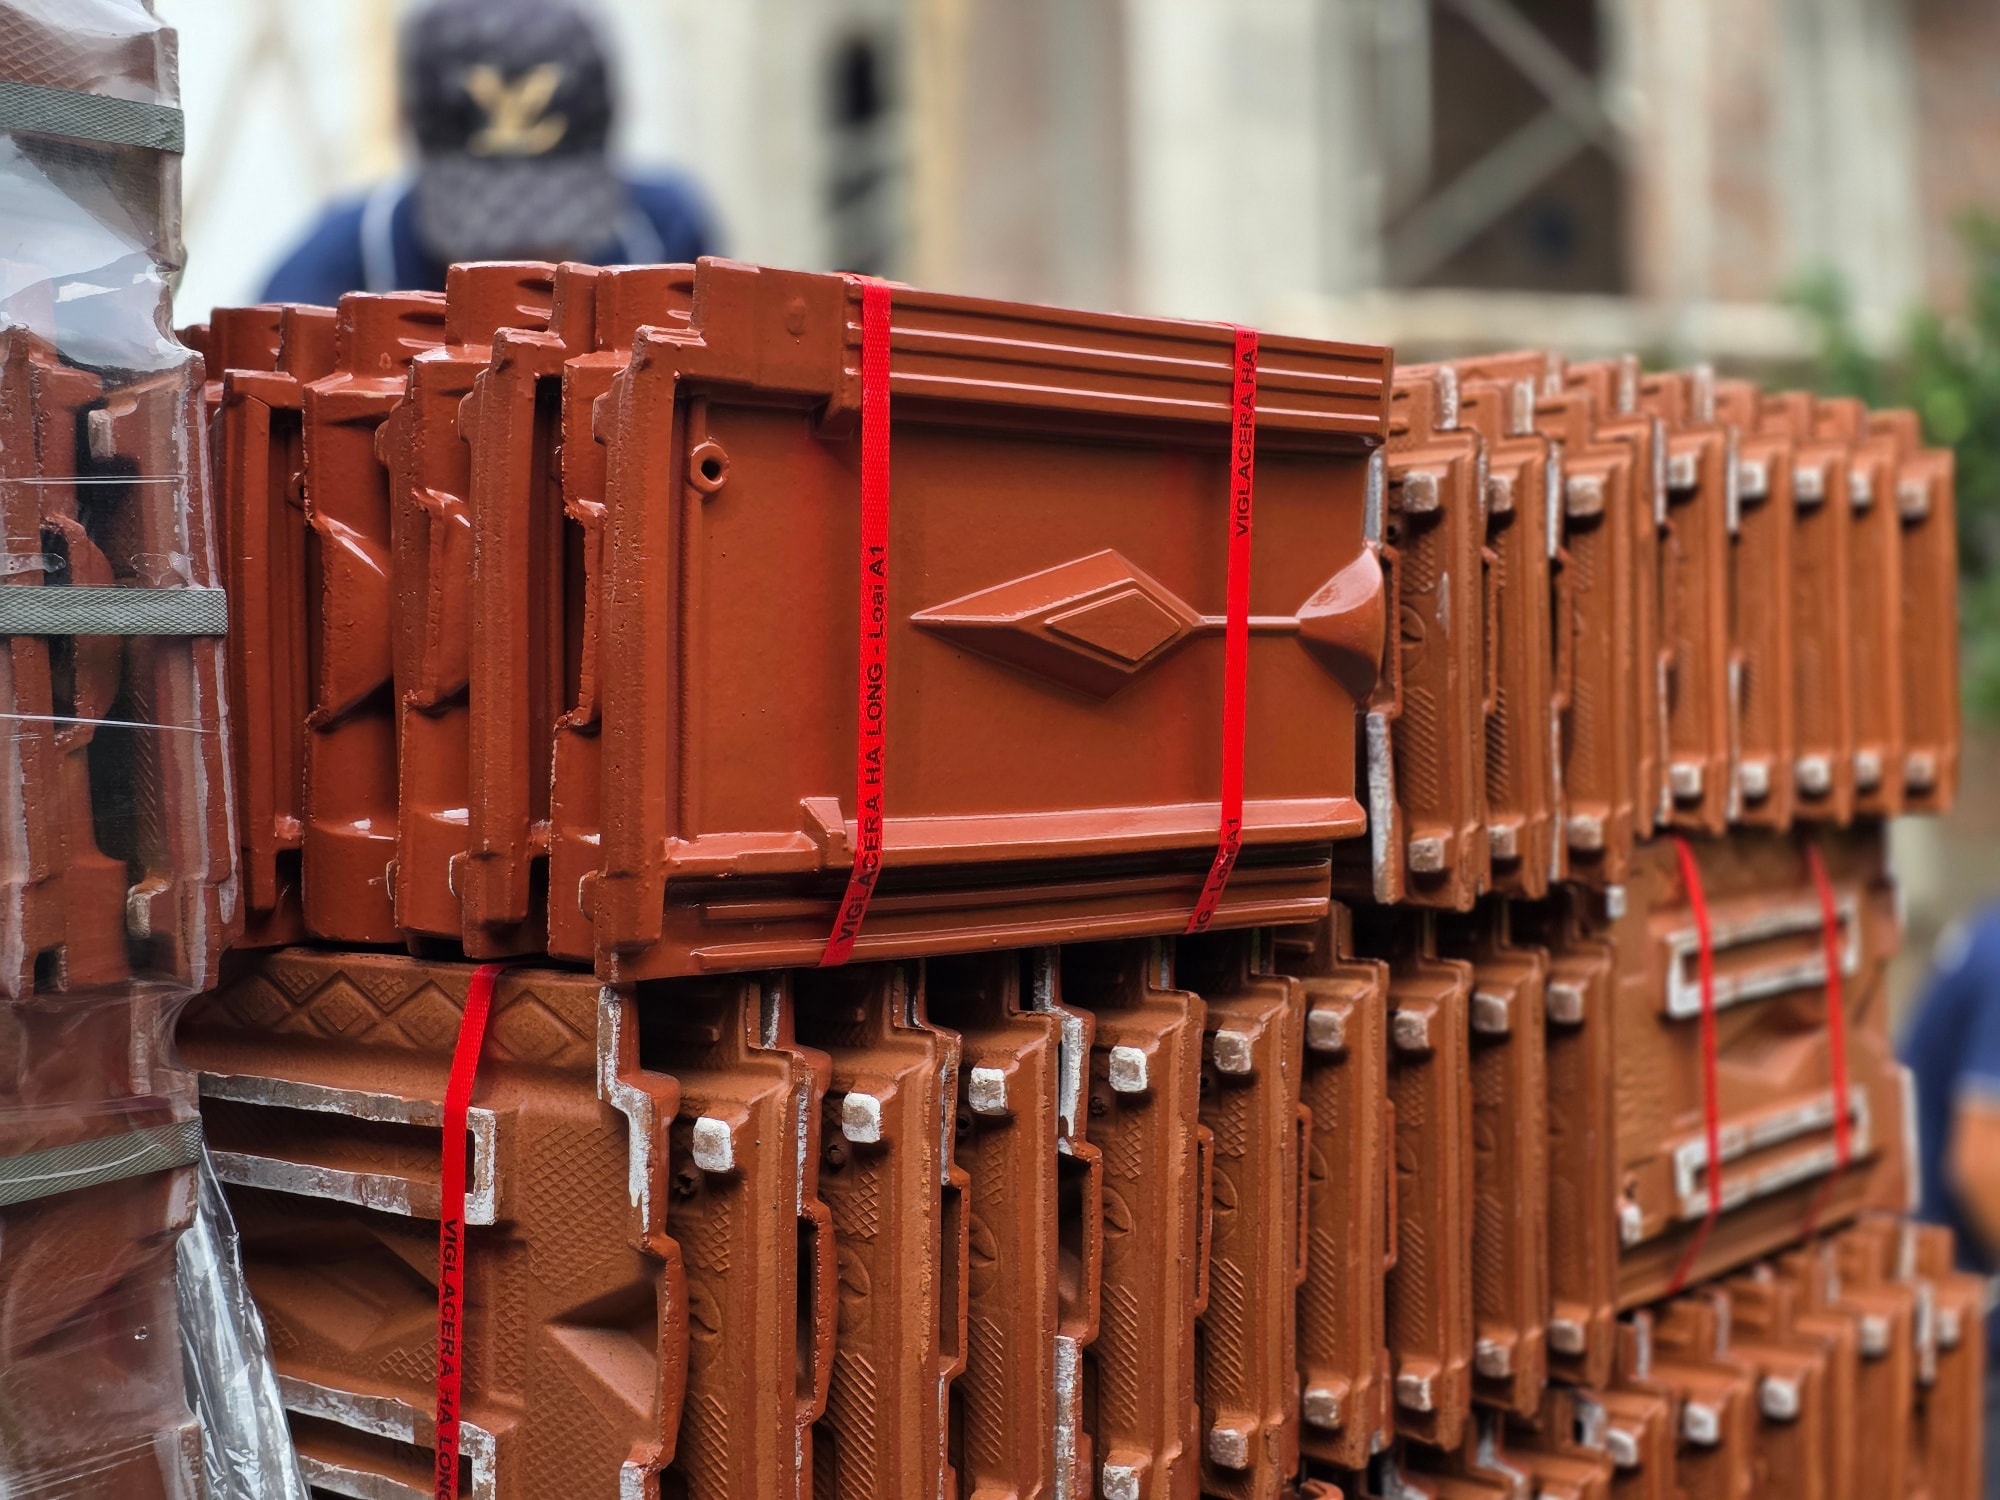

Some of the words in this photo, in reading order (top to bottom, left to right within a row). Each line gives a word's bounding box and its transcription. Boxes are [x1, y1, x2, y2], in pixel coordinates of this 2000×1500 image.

[1236, 392, 1254, 537] VIGLACERA
[868, 546, 884, 577] A1
[866, 663, 883, 736] LONG
[837, 793, 880, 943] VIGLACERA
[441, 1218, 458, 1377] VIGLACERA
